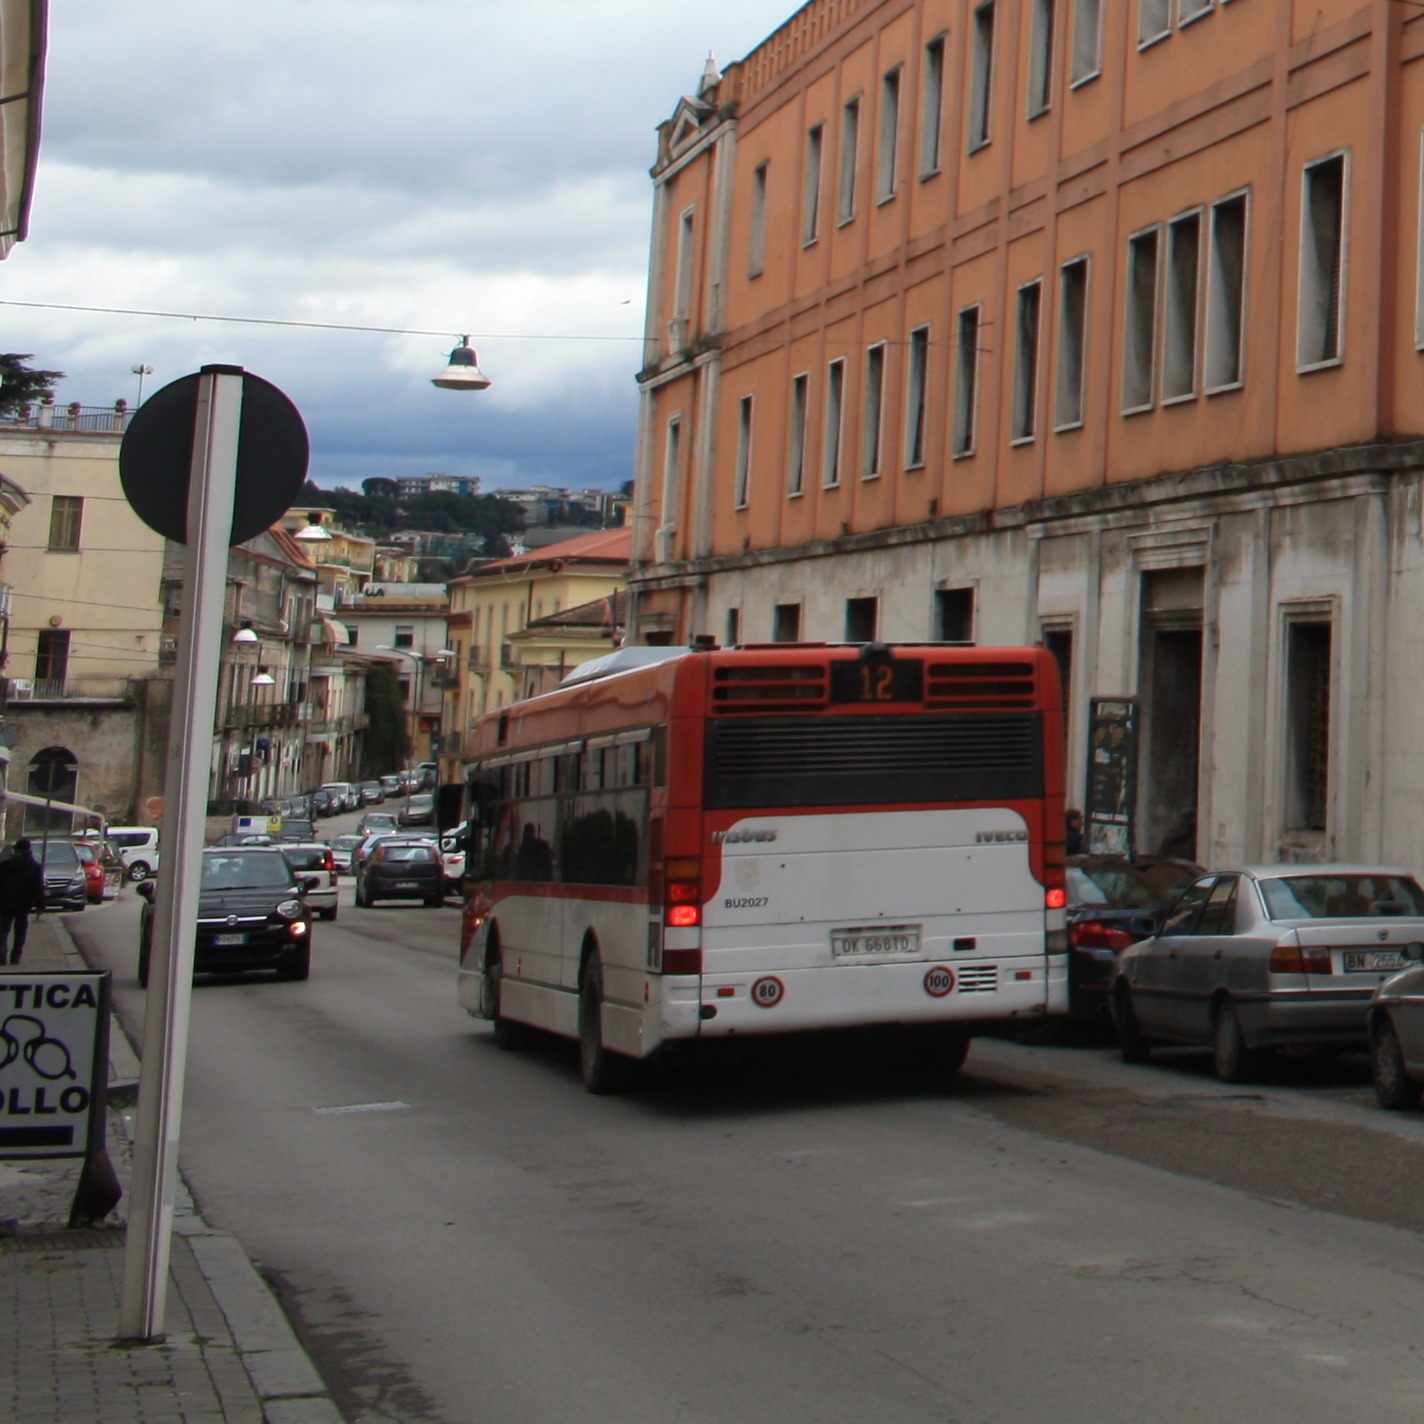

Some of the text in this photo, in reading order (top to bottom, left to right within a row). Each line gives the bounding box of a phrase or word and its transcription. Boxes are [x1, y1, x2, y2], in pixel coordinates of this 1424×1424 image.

[861, 664, 893, 699] 12
[975, 829, 1028, 844] IVECO
[724, 897, 769, 909] BU2027
[842, 938, 858, 954] DK
[929, 975, 949, 988] 100
[0, 983, 97, 1009] TICA
[759, 984, 776, 998] 80
[0, 1085, 89, 1114] LLO
